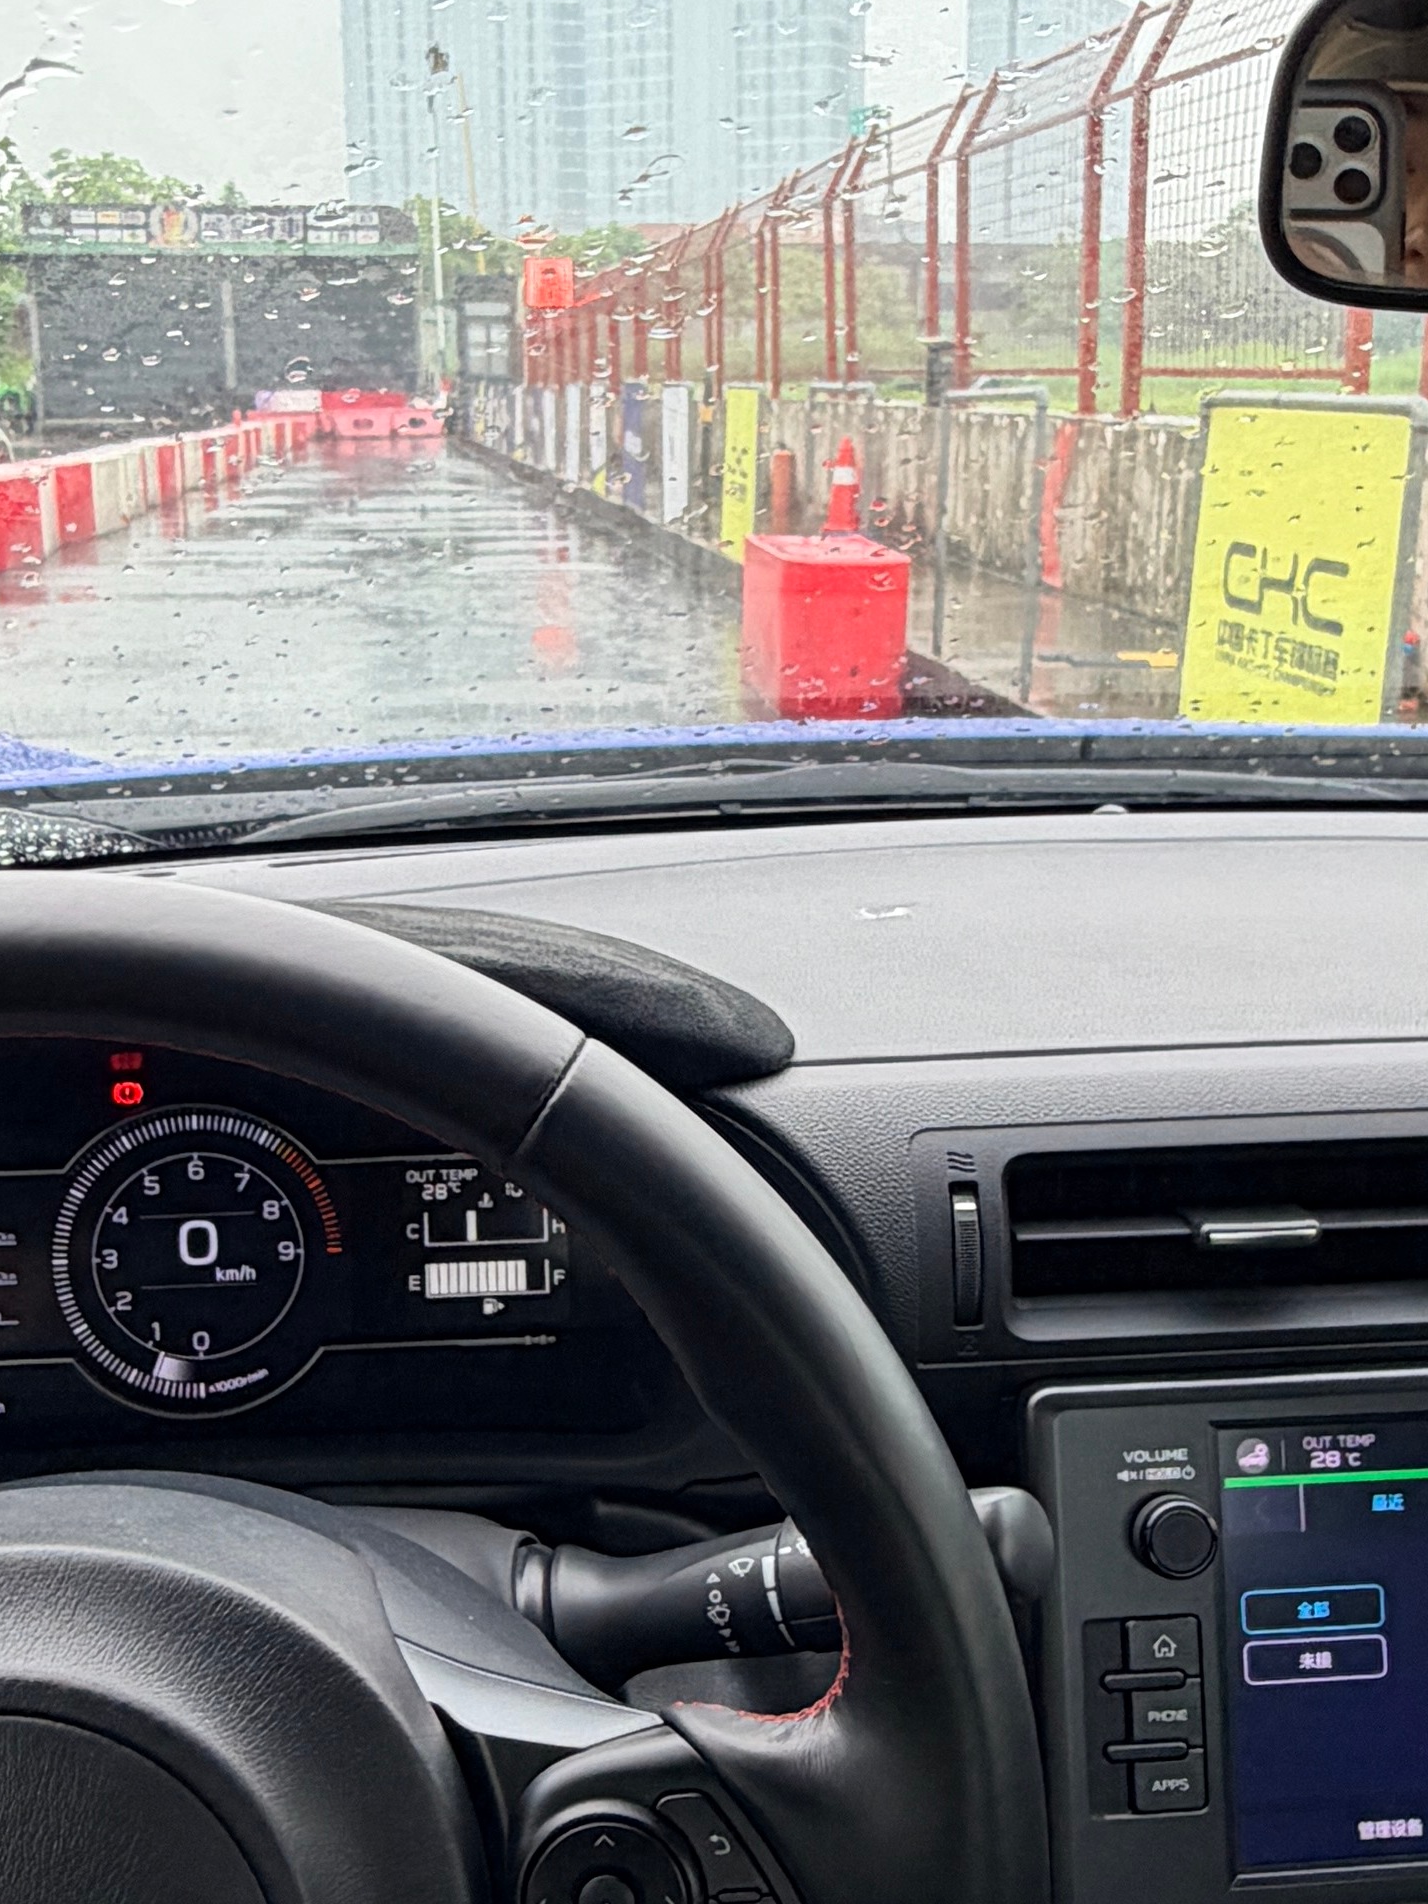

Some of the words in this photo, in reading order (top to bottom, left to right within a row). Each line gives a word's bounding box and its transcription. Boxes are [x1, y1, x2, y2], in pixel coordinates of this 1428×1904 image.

[187, 1160, 205, 1181] 6
[405, 1169, 436, 1183] OUT
[439, 1168, 478, 1181] TEMP
[143, 1175, 160, 1195] 5
[234, 1172, 250, 1192] 7
[112, 1206, 129, 1224] 4
[262, 1200, 280, 1220] 8
[405, 1223, 420, 1240] C
[551, 1218, 566, 1234] H
[178, 1219, 218, 1266] 0
[277, 1241, 295, 1261] 9
[101, 1249, 118, 1269] 3
[215, 1264, 257, 1282] km/h
[553, 1269, 566, 1285] F
[408, 1275, 422, 1292] E
[115, 1291, 133, 1311] 2
[151, 1321, 161, 1341] 1
[192, 1331, 210, 1351] 0
[1302, 1436, 1333, 1450] OUT
[1336, 1434, 1376, 1448] TEMP
[1123, 1448, 1189, 1464] VOLUME
[1148, 1709, 1188, 1723] PHONE
[1152, 1778, 1190, 1792] APPS
